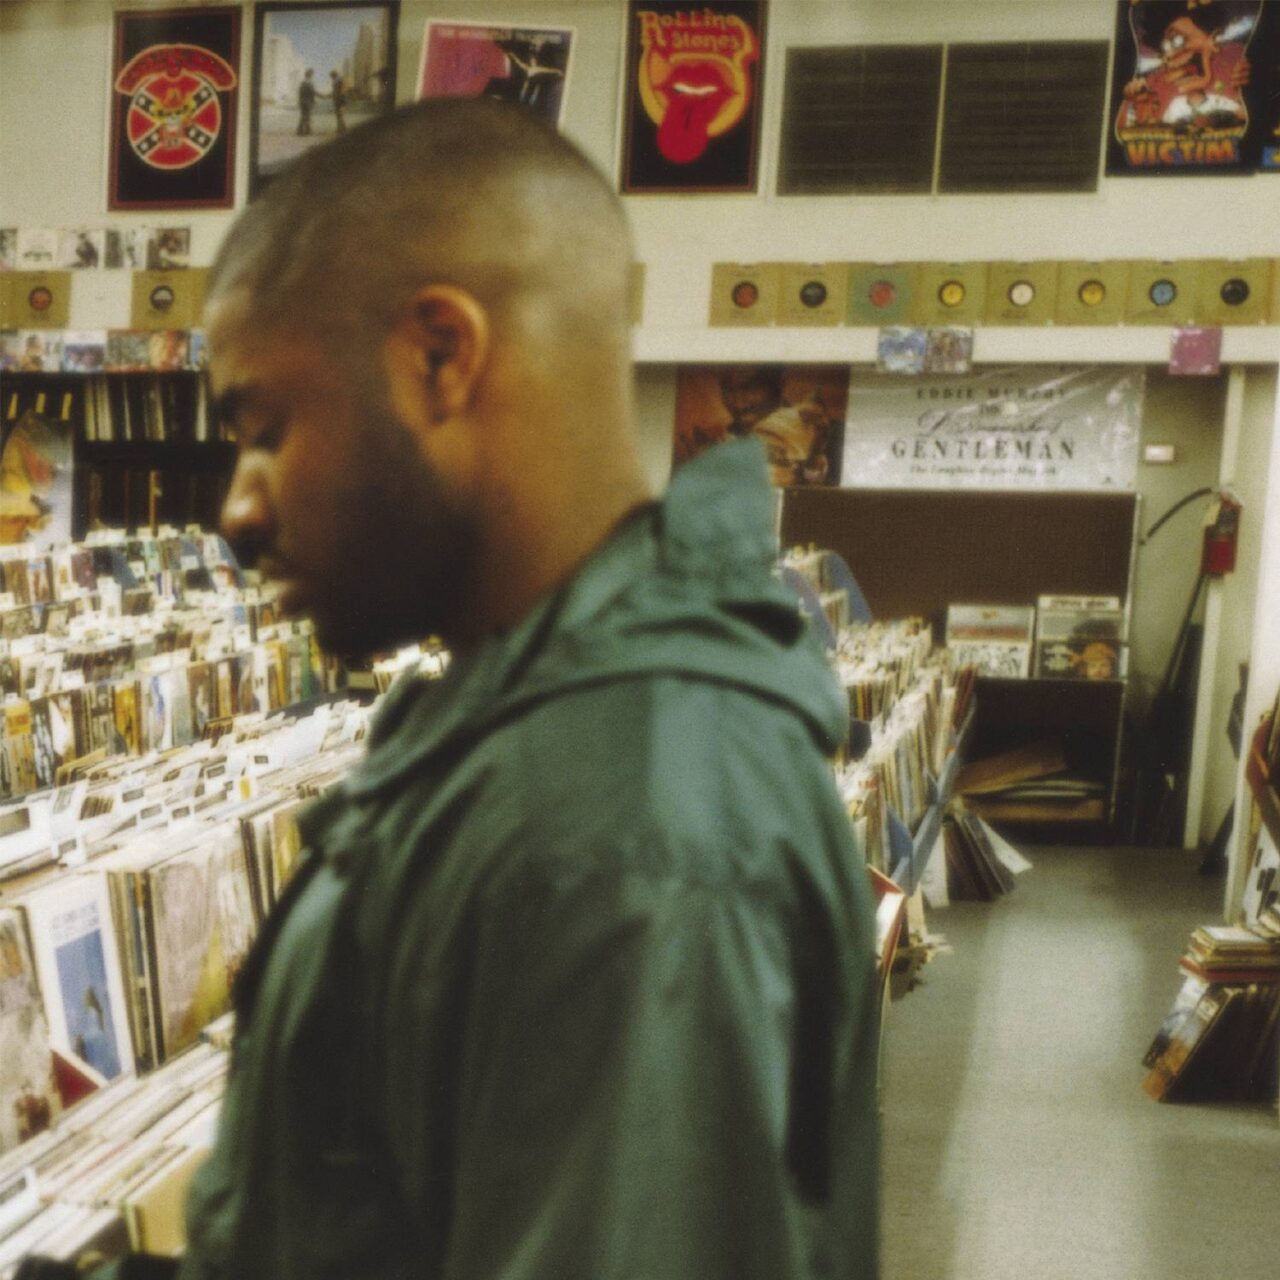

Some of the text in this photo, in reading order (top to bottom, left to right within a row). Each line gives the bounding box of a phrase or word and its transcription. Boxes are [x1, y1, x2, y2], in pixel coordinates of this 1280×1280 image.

[1127, 139, 1235, 165] VICTIM
[916, 387, 974, 400] EDDIE
[891, 439, 1075, 461] GENTLEMAN
